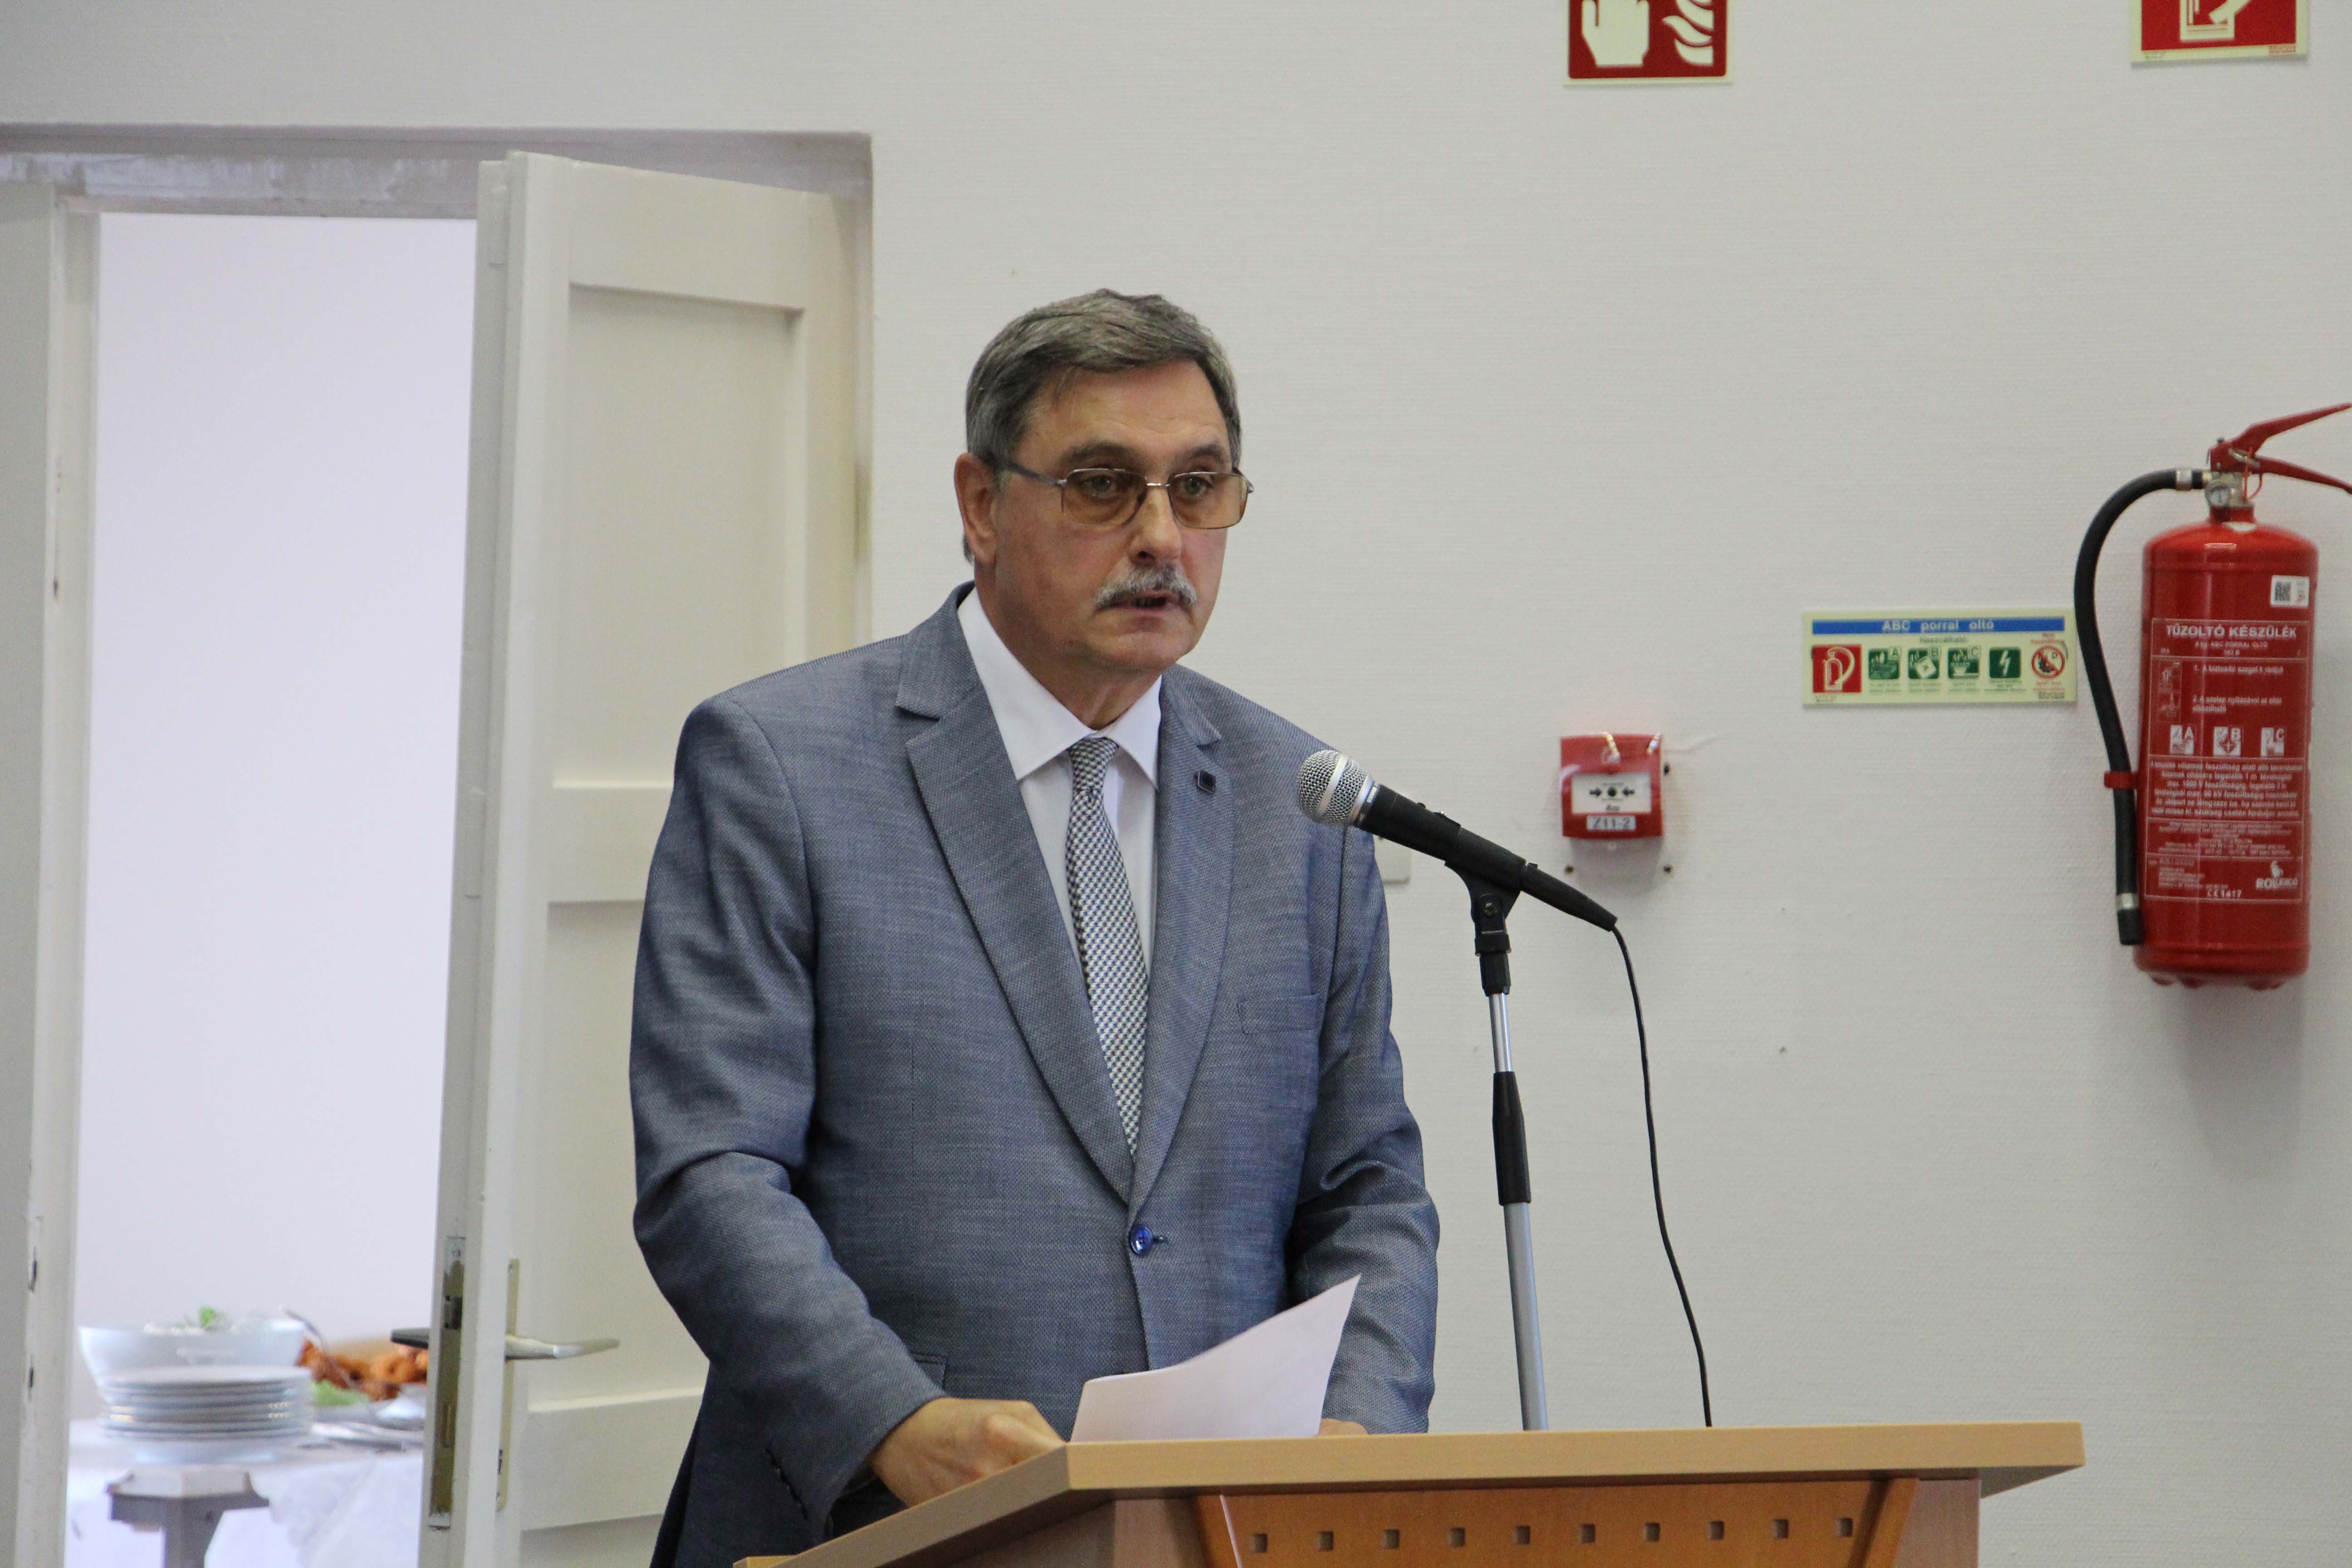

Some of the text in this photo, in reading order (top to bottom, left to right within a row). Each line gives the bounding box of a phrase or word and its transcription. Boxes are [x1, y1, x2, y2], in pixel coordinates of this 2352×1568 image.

[1882, 619, 1994, 633] ABC porral oltó
[2167, 623, 2297, 638] TŰZOLTÓ KÉSZÜLÉK
